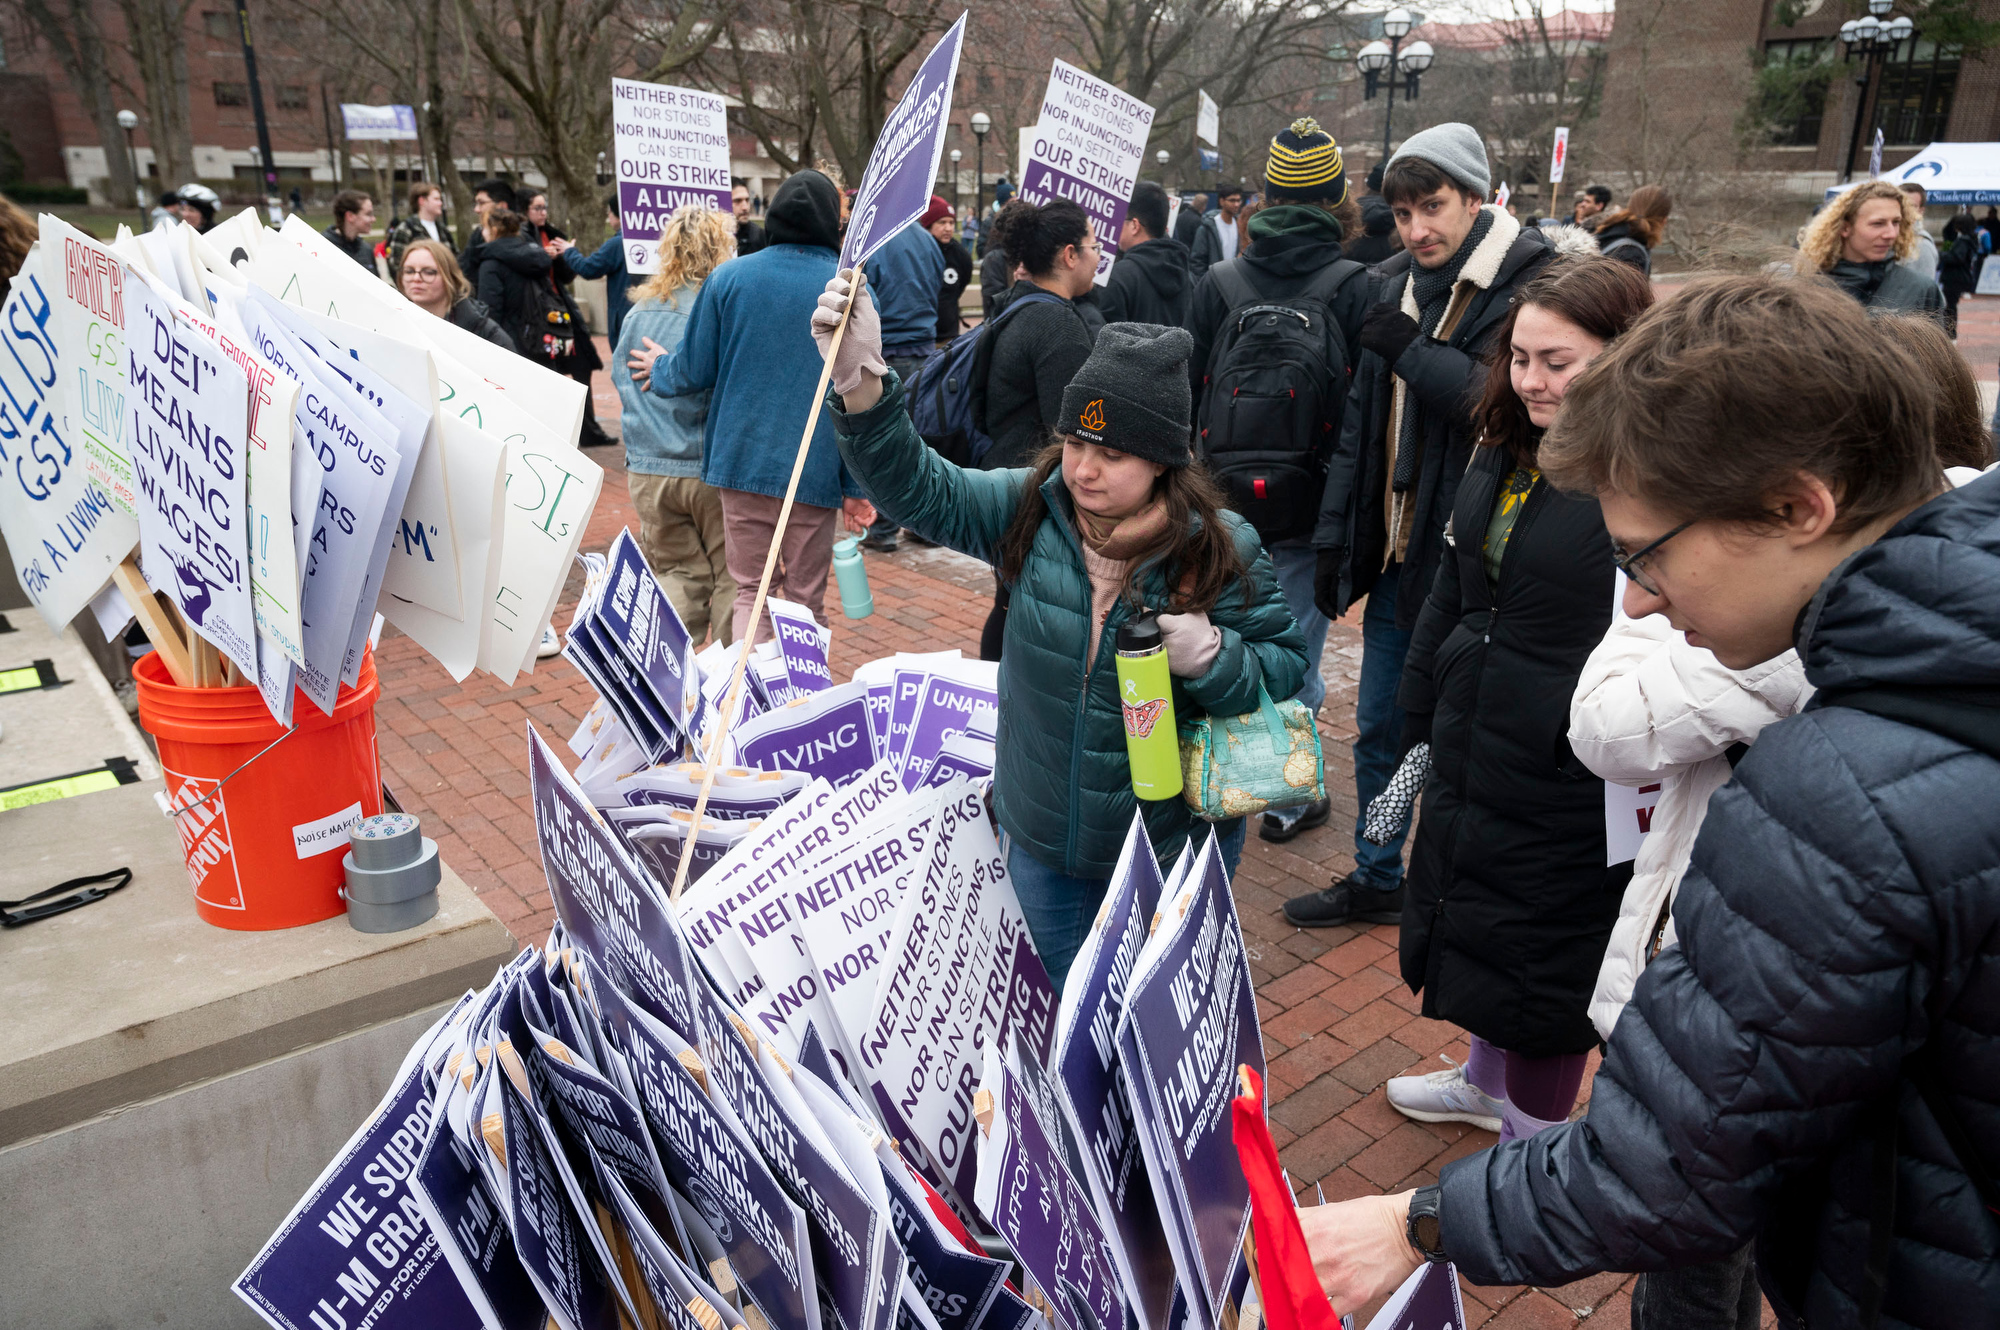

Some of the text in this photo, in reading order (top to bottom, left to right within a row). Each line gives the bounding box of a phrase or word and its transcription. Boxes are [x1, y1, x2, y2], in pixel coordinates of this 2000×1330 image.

[615, 84, 723, 113] NEITHER STICKS
[633, 105, 711, 128] NOR STONES
[1053, 65, 1151, 125] NEITHER STICKS
[1064, 91, 1135, 135] NOR STONES
[616, 123, 727, 147] NOR INJUNCTIONS
[638, 143, 712, 163] CAN SETTLE
[1043, 102, 1142, 159] NOR INJUNCTIONS
[1057, 127, 1124, 169] CAN SETTLE
[621, 159, 729, 187] OUR STRIKE
[636, 188, 719, 212] A LIVING
[1034, 139, 1134, 198] OUR STRIKE
[1038, 172, 1117, 219] A LIVING
[130, 348, 234, 481] MEANS
[306, 393, 387, 476] CAMPUS
[1076, 429, 1104, 442] IFNOTNOW
[134, 408, 231, 531] LIVING
[23, 483, 114, 604] FOR A LIVING
[133, 455, 242, 593] WAGES!
[203, 622, 252, 671] ORGANIZATION
[215, 614, 250, 652] GRADUATE
[271, 623, 302, 661] STUDIES
[831, 769, 898, 836] STICKS
[551, 787, 575, 846] WE
[576, 819, 642, 931] SUPPORT
[795, 838, 908, 920] NEITHER
[540, 798, 565, 866] U-M
[563, 841, 605, 918] GRAD
[603, 893, 691, 1025] WORKERS
[841, 888, 895, 935] NOR
[870, 912, 930, 1065] NEITHER
[922, 806, 956, 914] STICKS
[823, 943, 880, 993] NOR
[900, 864, 963, 1048] NOR STONES
[900, 1044, 934, 1120] NOR
[927, 858, 985, 1046] INJUNCTIONS
[1089, 991, 1117, 1073] WE
[1108, 887, 1146, 1018] SUPPORT
[1169, 887, 1220, 1032] WE SUPPORT
[935, 917, 992, 1092] CAN SETTLE
[939, 906, 1016, 1169] OUR STRIKE
[707, 1004, 799, 1154] SUPPORT
[1164, 1046, 1201, 1139] U-M
[1192, 992, 1225, 1085] GRAD
[627, 1020, 659, 1081] WE
[660, 1059, 749, 1183] SUPPORT
[1183, 1111, 1208, 1161] UNITED
[1094, 1088, 1125, 1193] U-M
[244, 1245, 277, 1284] AFFORDABLE
[274, 1216, 302, 1248] CHILDCARE
[302, 1191, 322, 1215] GENDER
[320, 1165, 344, 1193] AFFIRMING
[341, 1133, 370, 1168] HEALTHCARE
[370, 1127, 376, 1135] A
[373, 1112, 389, 1130] LIVING
[386, 1100, 398, 1115] WAGE
[397, 1076, 413, 1100] SMALLER
[519, 1175, 542, 1238] WE
[642, 1072, 695, 1154] GRAD
[698, 1133, 799, 1287] WORKERS
[741, 1089, 861, 1268] WORKERS
[318, 1184, 378, 1248] WE
[457, 1184, 492, 1260] U-M
[702, 1168, 723, 1196] AND
[724, 1193, 798, 1292] AFFORDABILITY
[245, 1283, 279, 1315] HEALTHCARE
[308, 1256, 381, 1330] U-M
[390, 1258, 419, 1292] FOR
[402, 1261, 435, 1300] AFT LOCAL
